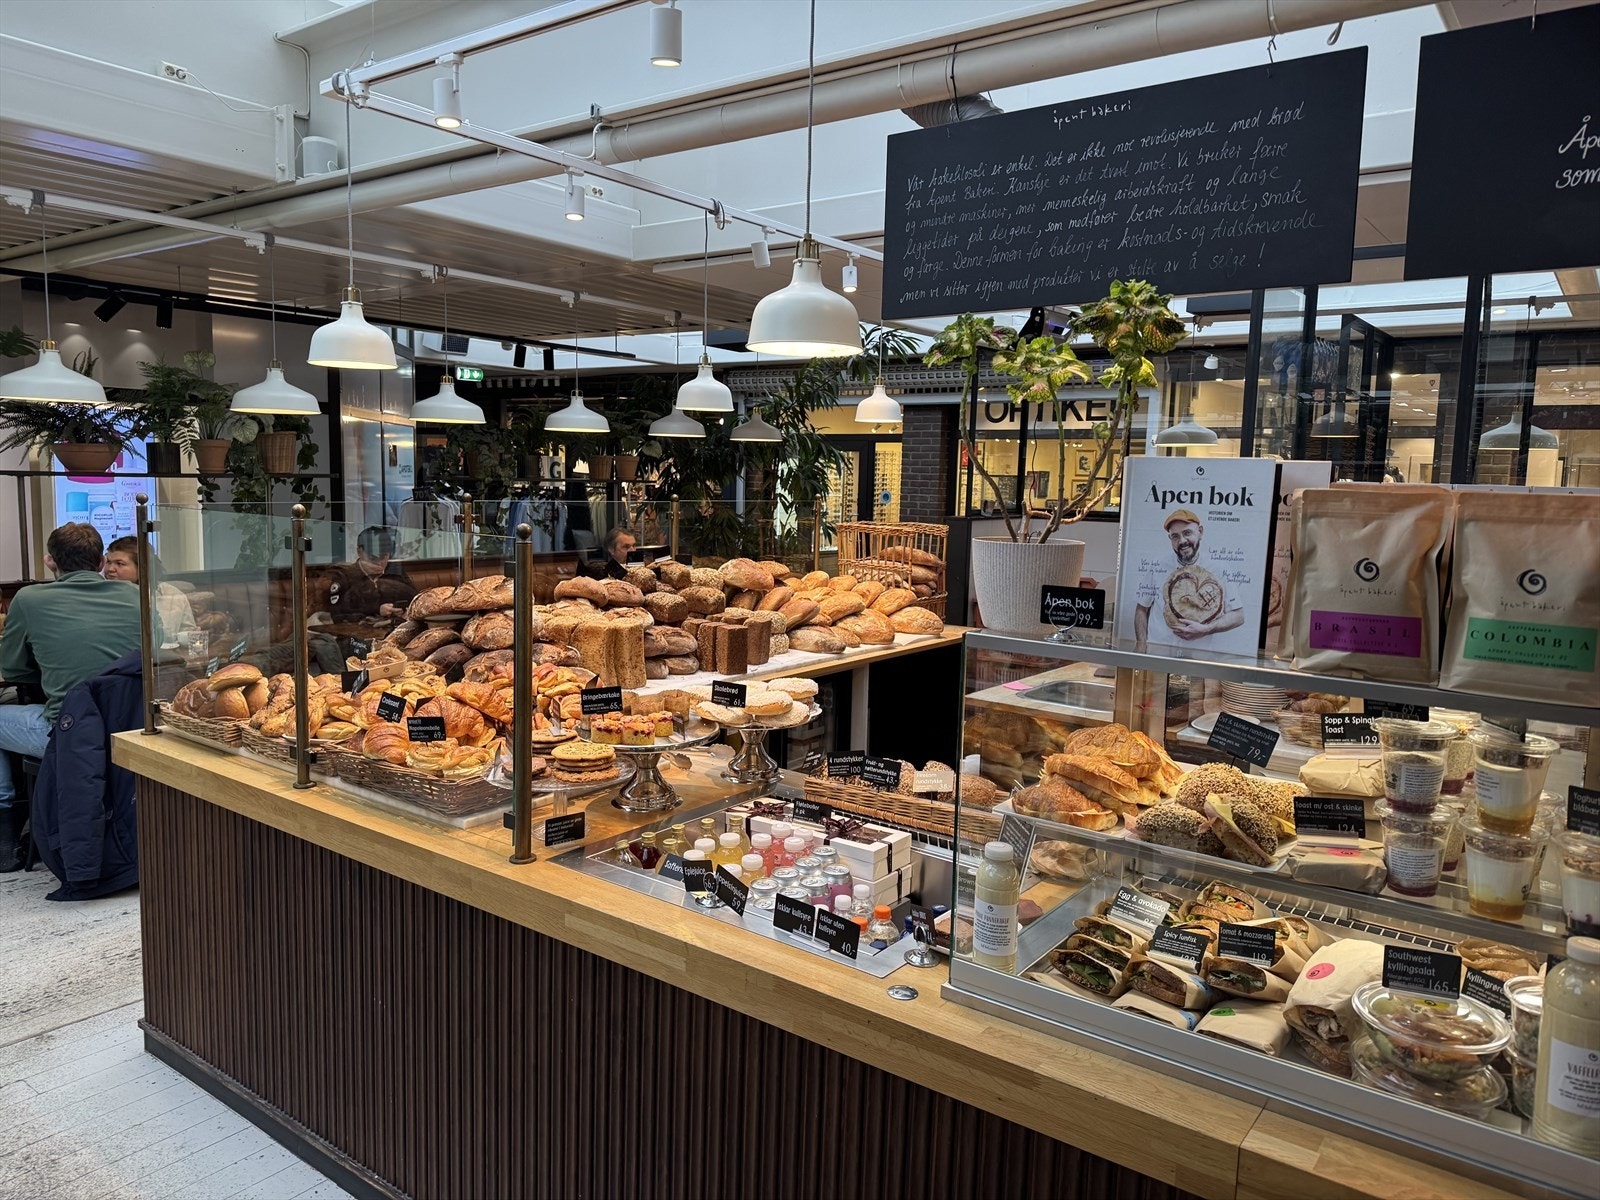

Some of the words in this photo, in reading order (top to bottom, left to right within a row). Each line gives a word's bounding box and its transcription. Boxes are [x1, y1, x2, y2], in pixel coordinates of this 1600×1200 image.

[1053, 109, 1087, 130] åpent
[1091, 100, 1131, 117] bakeri
[906, 177, 924, 193] Vår
[990, 164, 1003, 176] er
[1005, 154, 1039, 174] enkel.
[1044, 150, 1063, 168] Det
[1067, 152, 1078, 164] er
[1079, 141, 1106, 163] ikke
[1228, 109, 1262, 133] med
[1266, 101, 1305, 126] brød
[904, 190, 922, 215] fra
[1004, 172, 1051, 197] Kanskje
[1058, 175, 1071, 186] er
[1075, 166, 1094, 184] det
[1100, 160, 1130, 180] tvert
[1197, 141, 1242, 167] bruker
[904, 220, 917, 236] og
[1015, 203, 1036, 216] mer
[1043, 192, 1108, 211] menneskelig
[1114, 173, 1197, 202] arbeidskraft
[1205, 178, 1220, 197] og
[1227, 165, 1283, 188] lange
[903, 234, 958, 261] liggetider
[967, 227, 985, 250] på
[1044, 220, 1063, 232] som
[1068, 208, 1119, 231] medfører
[1126, 203, 1164, 224] bedre
[1260, 179, 1308, 208] smak
[903, 266, 914, 282] og
[985, 248, 1022, 268] formen
[1026, 243, 1042, 263] for
[1048, 234, 1094, 263] baking
[1097, 237, 1110, 250] er
[1191, 229, 1206, 249] og
[1210, 209, 1324, 241] tidskrevende
[899, 288, 926, 304] men
[943, 279, 970, 298] sitter
[974, 275, 1003, 301] igjen
[1007, 273, 1031, 290] med
[1032, 265, 1084, 295] produkter
[1163, 258, 1180, 274] av
[1145, 480, 1203, 510] Åpen
[1209, 485, 1254, 507] bok
[1075, 597, 1095, 610] bok
[1314, 622, 1410, 638] BRASIL
[1470, 630, 1590, 651] COLOMBIA
[714, 684, 740, 695] Skolebrød
[1324, 716, 1343, 725] Sopp
[1344, 716, 1351, 724] &
[1325, 725, 1345, 734] Toast
[1247, 746, 1266, 761] 79,-
[684, 866, 706, 877] Eplejuice
[1118, 889, 1131, 901] Egg
[1131, 895, 1138, 903] &
[1138, 896, 1167, 914] avokado
[791, 907, 812, 922] kullsyre
[818, 922, 837, 937] kullsyre
[832, 920, 846, 931] uten
[1178, 932, 1198, 944] Tunfisk
[1220, 926, 1237, 936] Tomat
[1244, 930, 1275, 942] mozzarella
[1388, 949, 1432, 965] Southwest
[1387, 961, 1436, 977] kyllingsalat
